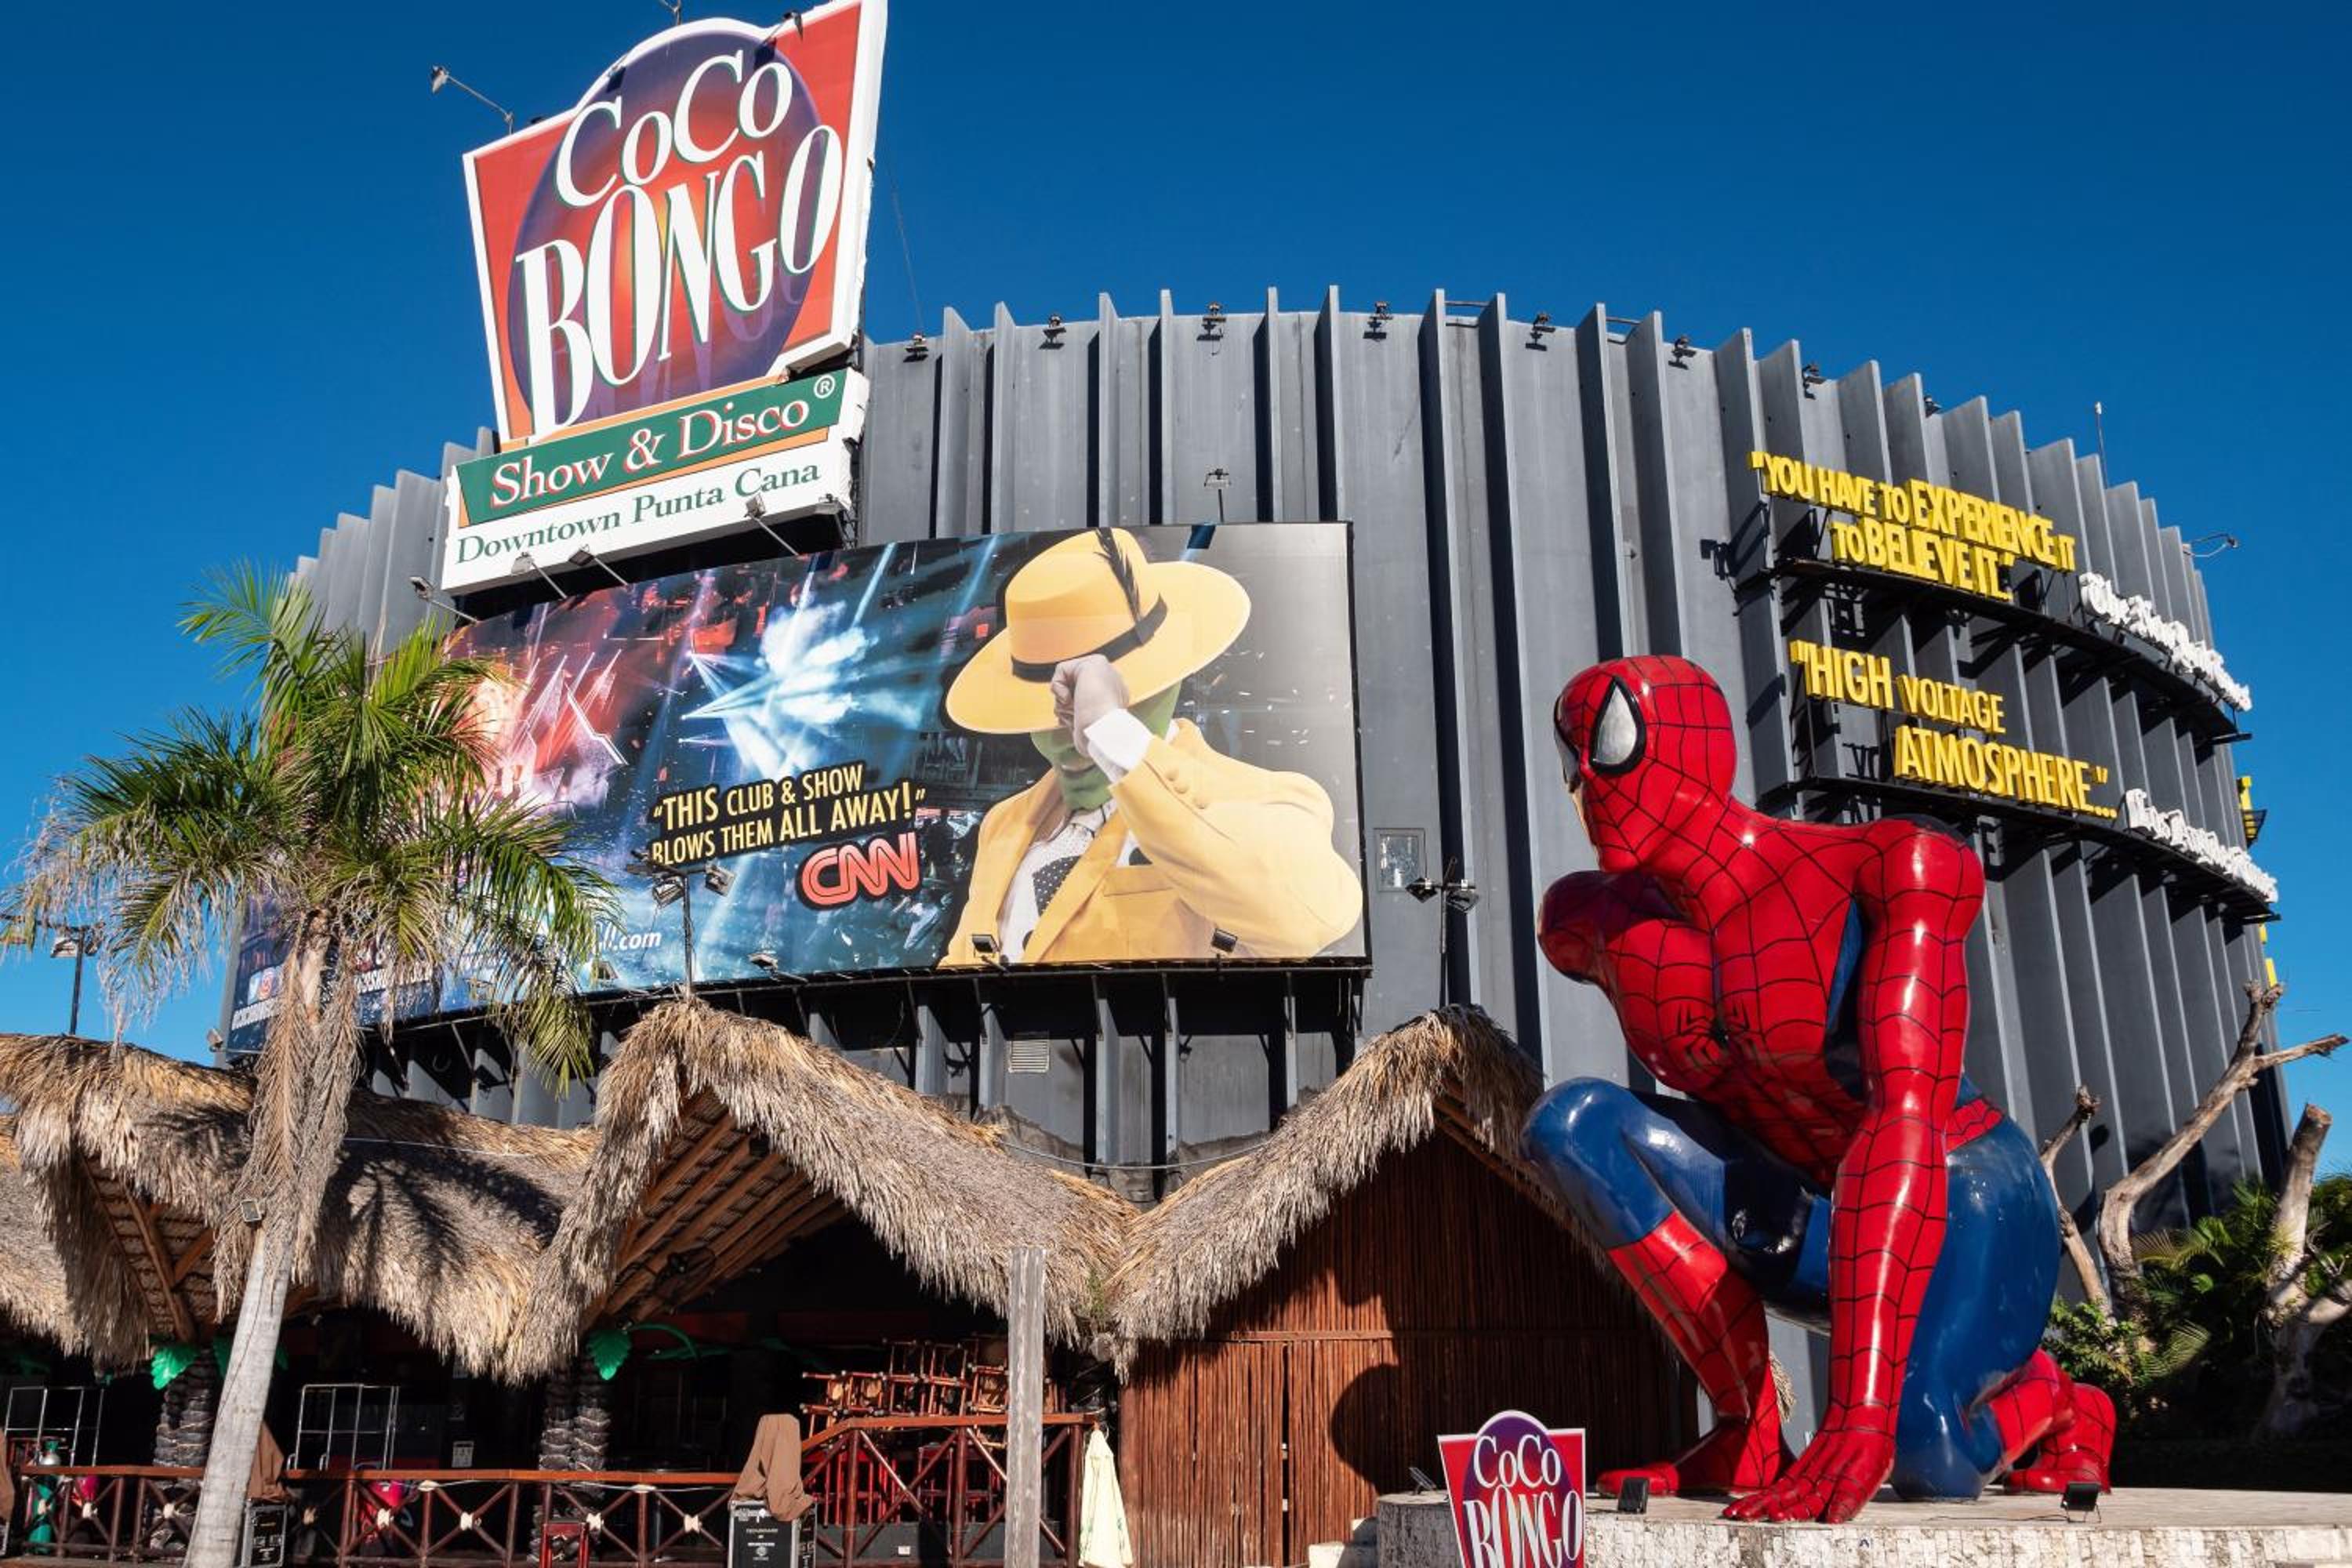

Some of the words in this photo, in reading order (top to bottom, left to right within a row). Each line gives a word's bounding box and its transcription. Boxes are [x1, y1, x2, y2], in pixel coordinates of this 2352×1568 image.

[554, 49, 793, 208] CoCo
[515, 125, 843, 444] BONGO
[491, 452, 615, 508] Show
[625, 427, 666, 472] &
[677, 401, 810, 460] Disco
[456, 510, 622, 564] Downtown
[625, 488, 726, 524] Punta
[735, 463, 822, 497] Cana
[1814, 466, 1876, 515] HAVE
[1878, 482, 1910, 524] TO
[1905, 478, 2058, 568] EXPERIENCE
[2055, 534, 2076, 572] IT
[1830, 520, 1865, 564] TO
[1861, 516, 1976, 592] BELIEVE
[1791, 639, 1894, 710] "HIGH
[1895, 673, 2006, 735] VOLTAGE
[652, 786, 720, 831] "THIS
[726, 782, 775, 817] CLUB
[781, 780, 797, 805] &
[803, 764, 864, 802] SHOW
[652, 829, 716, 866] BLOWS
[720, 817, 774, 854] THEM
[779, 806, 822, 842] ALL
[800, 831, 920, 906] CNN
[1473, 1433, 1562, 1489] CoCo
[1462, 1484, 1584, 1568] BONGO
